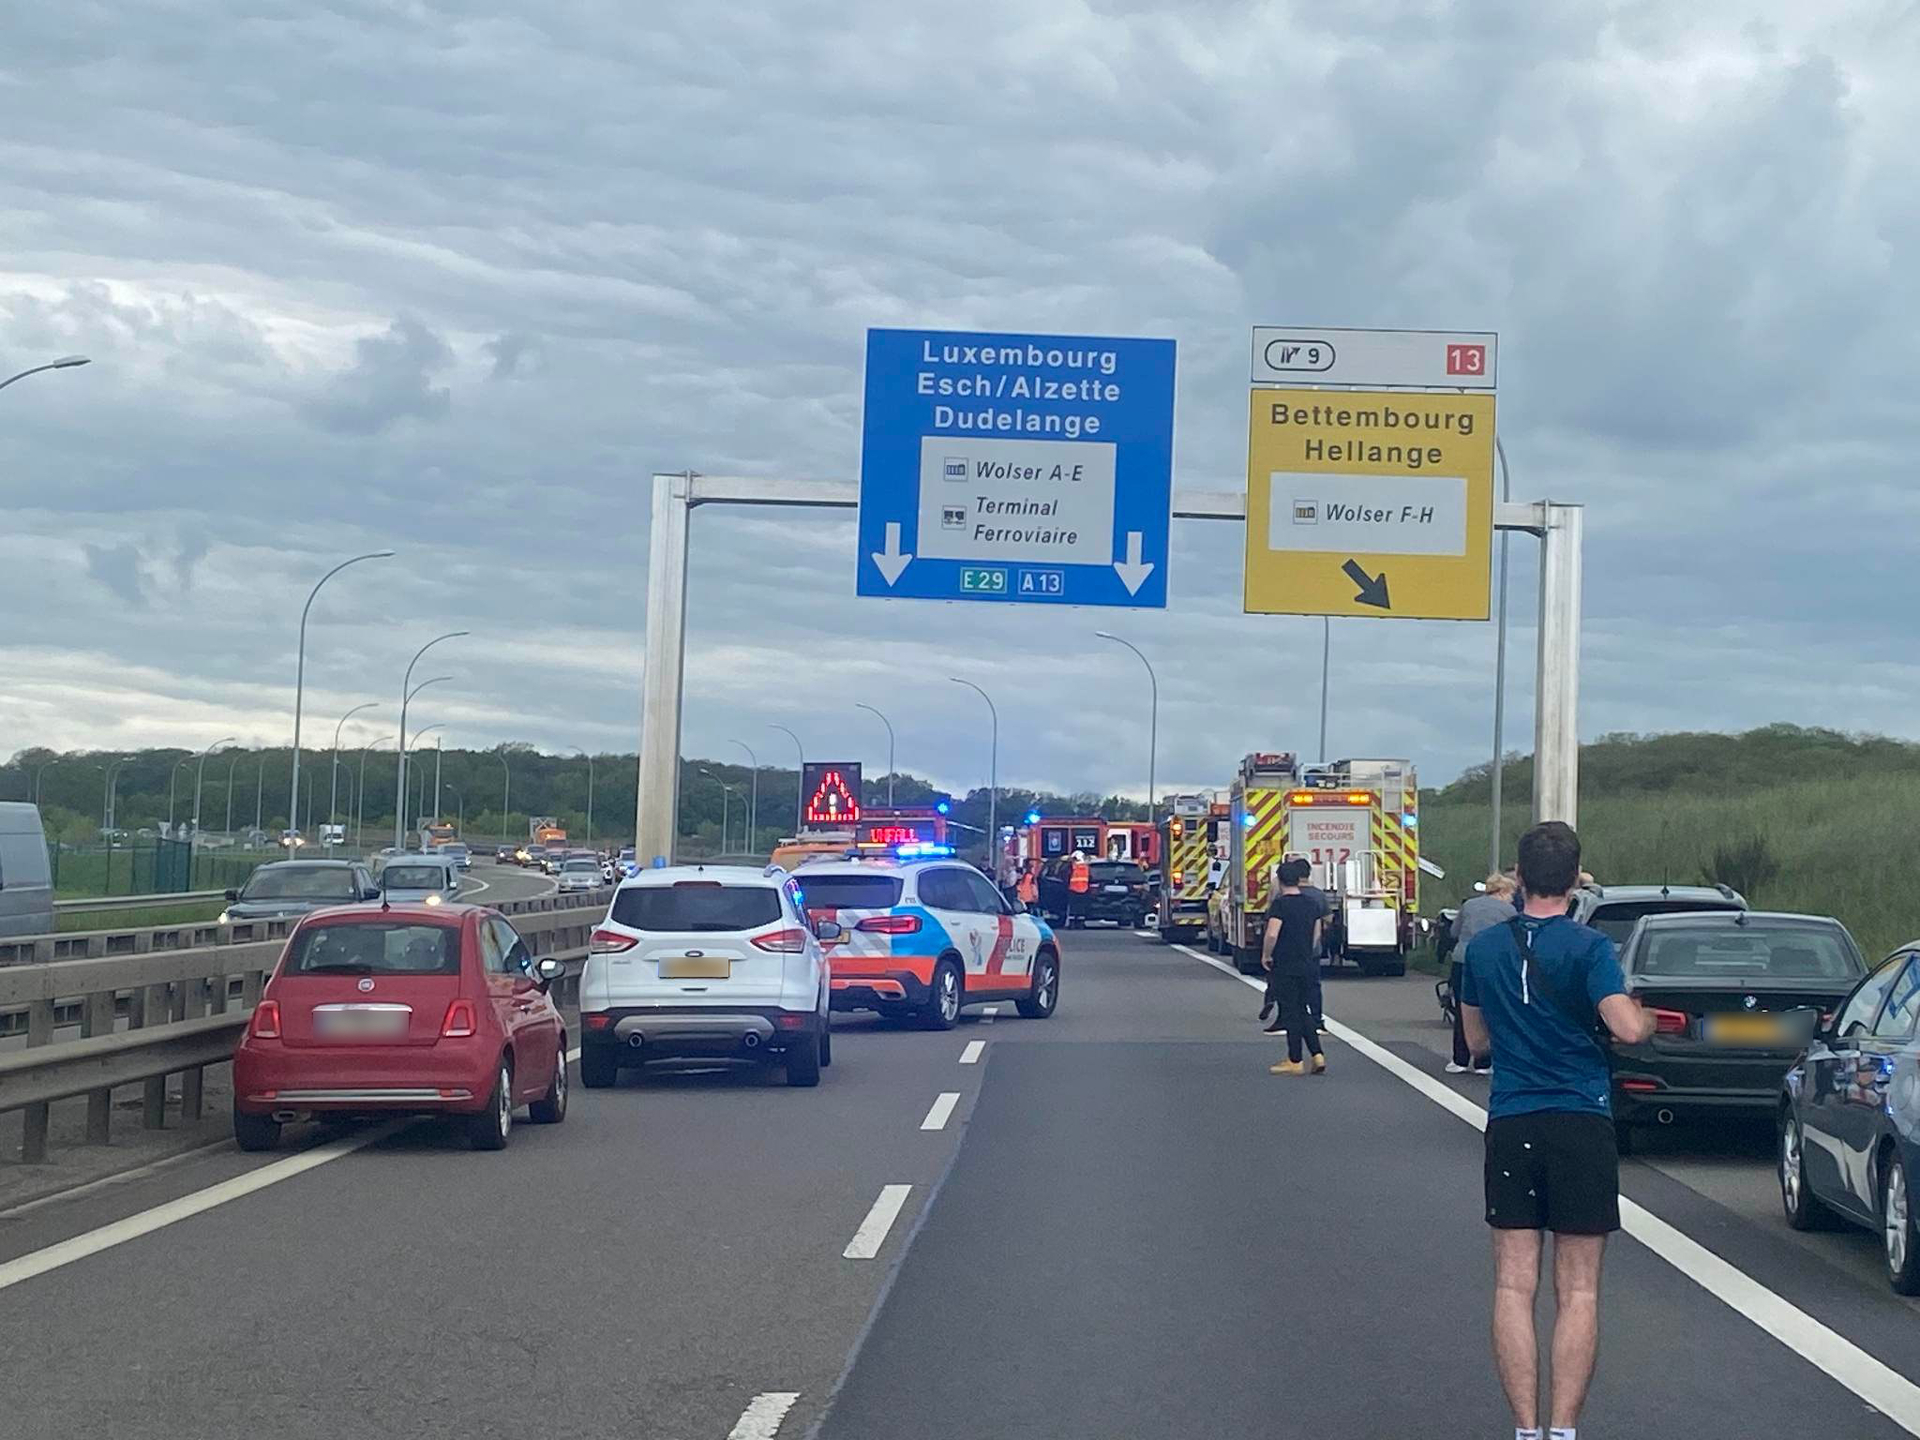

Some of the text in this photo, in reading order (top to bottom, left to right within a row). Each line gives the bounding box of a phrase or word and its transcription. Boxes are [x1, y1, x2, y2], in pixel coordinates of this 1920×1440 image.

[923, 340, 1117, 375] Luxembourg
[1308, 347, 1320, 365] 9
[1450, 349, 1481, 371] 13
[917, 374, 1120, 402] Esch/Alzette
[934, 405, 1101, 439] Dudelange
[1271, 403, 1475, 436] Bettembourg
[1305, 438, 1443, 469] Hellange
[977, 461, 1084, 482] Wolser A-E
[976, 496, 1058, 516] Terminal
[1326, 503, 1434, 524] Wolser F-H
[973, 523, 1078, 545] Ferroviaire
[1307, 823, 1355, 831] INCENDIE
[1308, 832, 1355, 840] SECOURS
[1076, 838, 1095, 848] 112
[1311, 848, 1350, 865] 112
